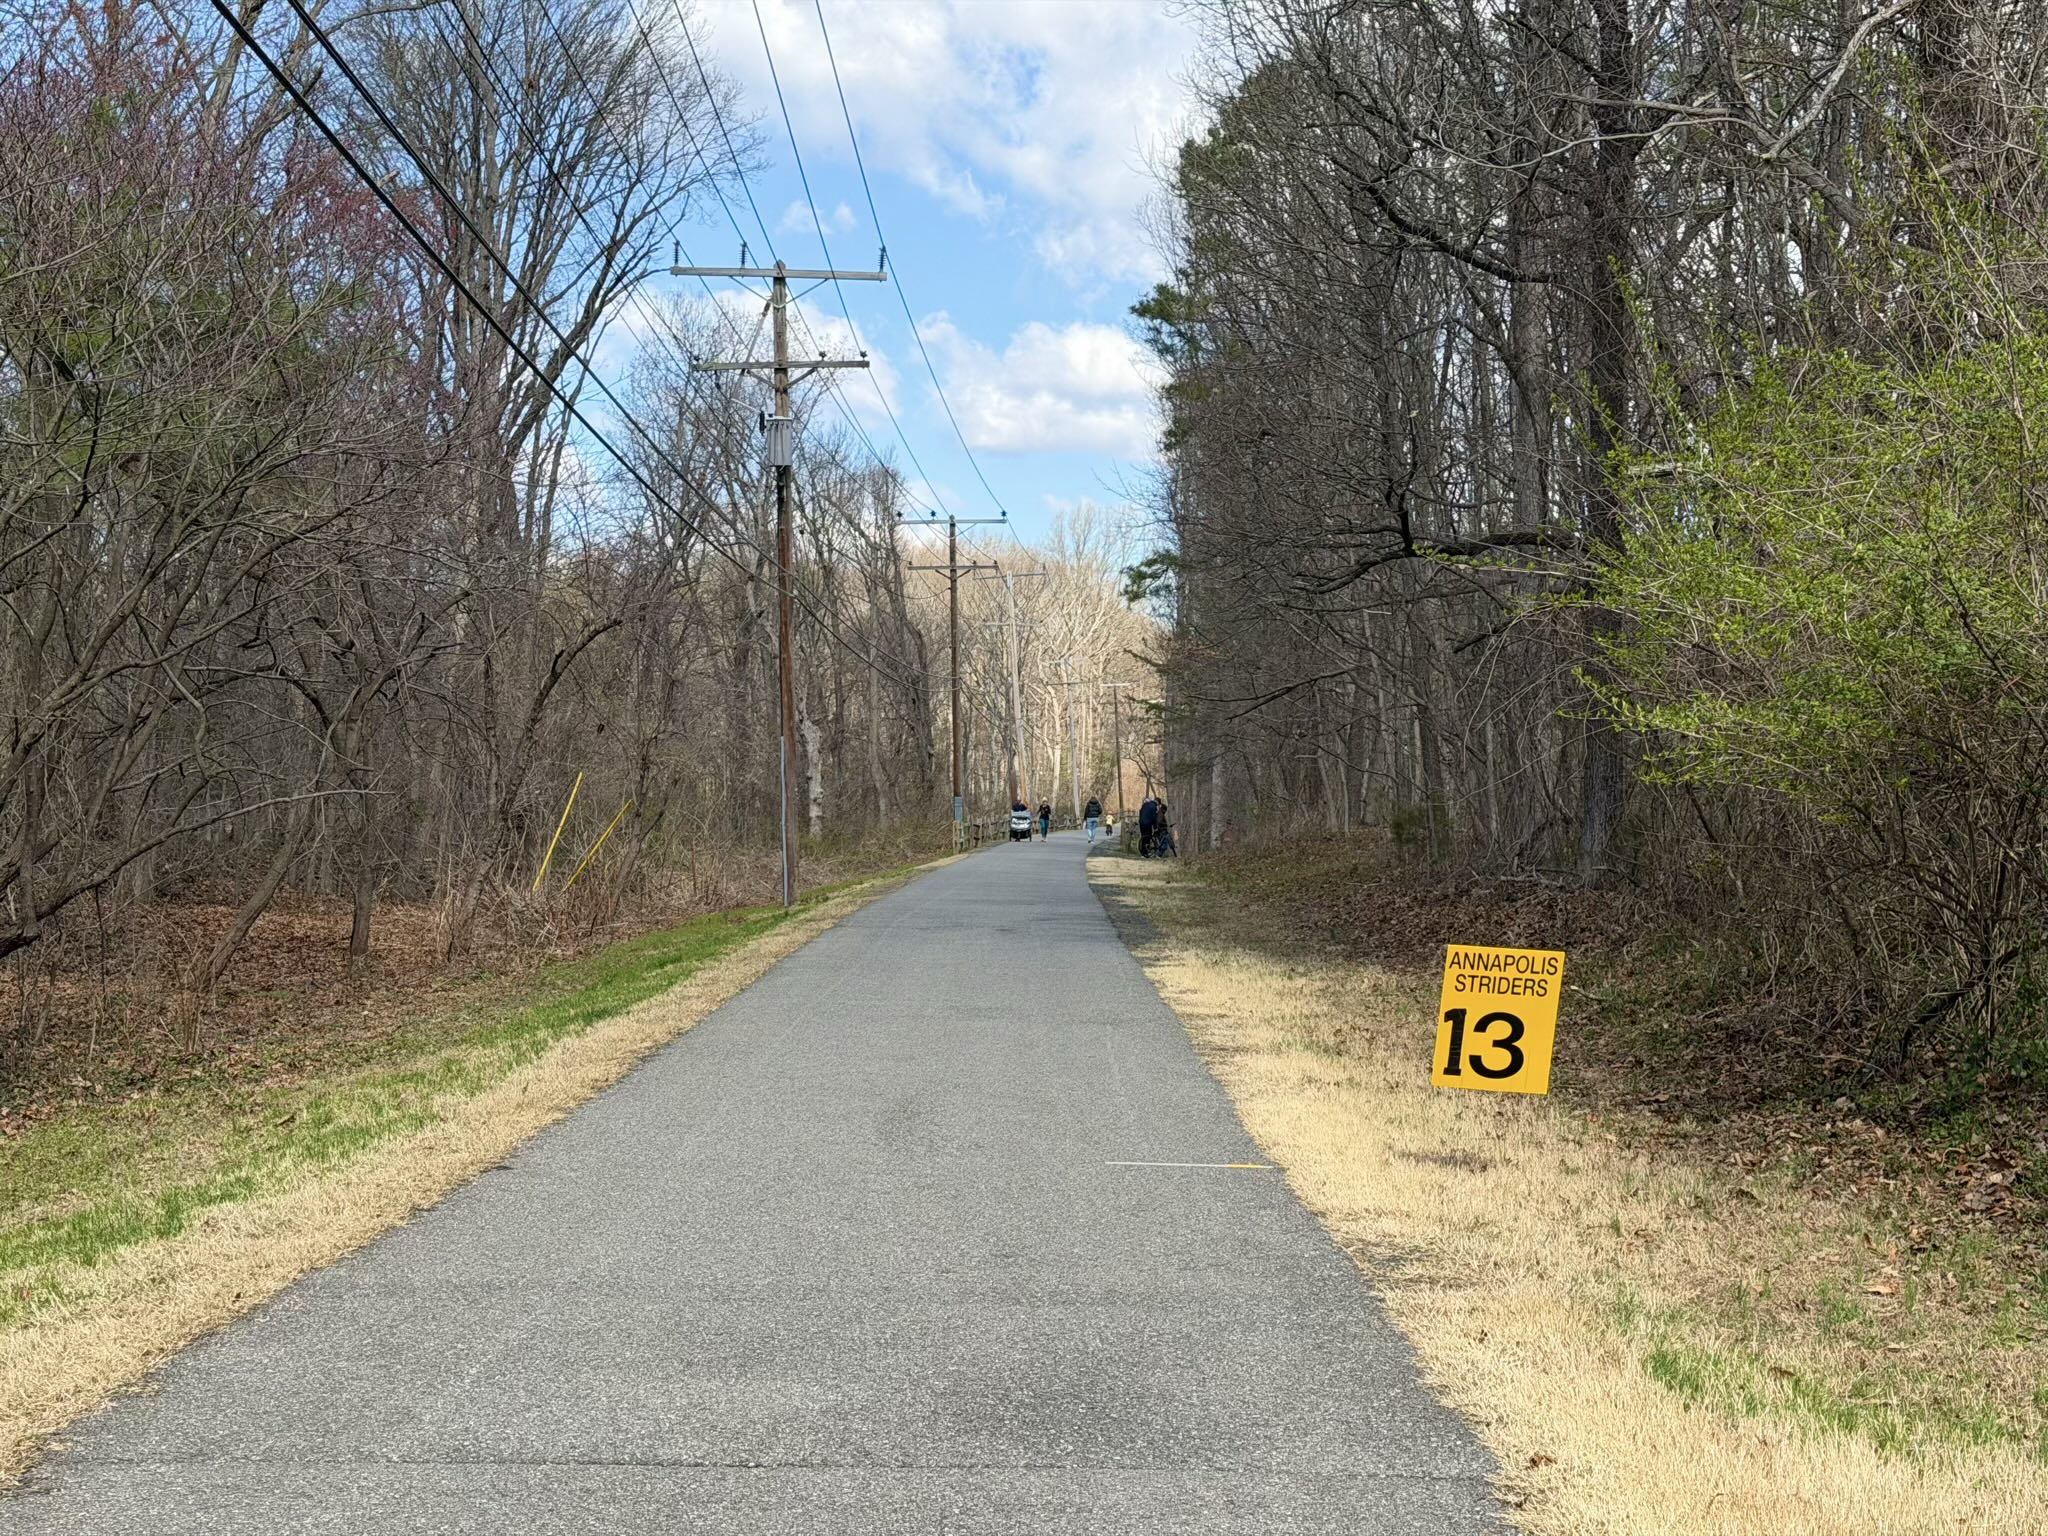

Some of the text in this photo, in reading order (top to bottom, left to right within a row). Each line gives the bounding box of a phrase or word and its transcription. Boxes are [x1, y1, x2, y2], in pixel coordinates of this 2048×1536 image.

[1449, 951, 1559, 976] ANNAPOLIS
[1454, 974, 1548, 997] STRIDERS
[1443, 1008, 1525, 1080] 13
